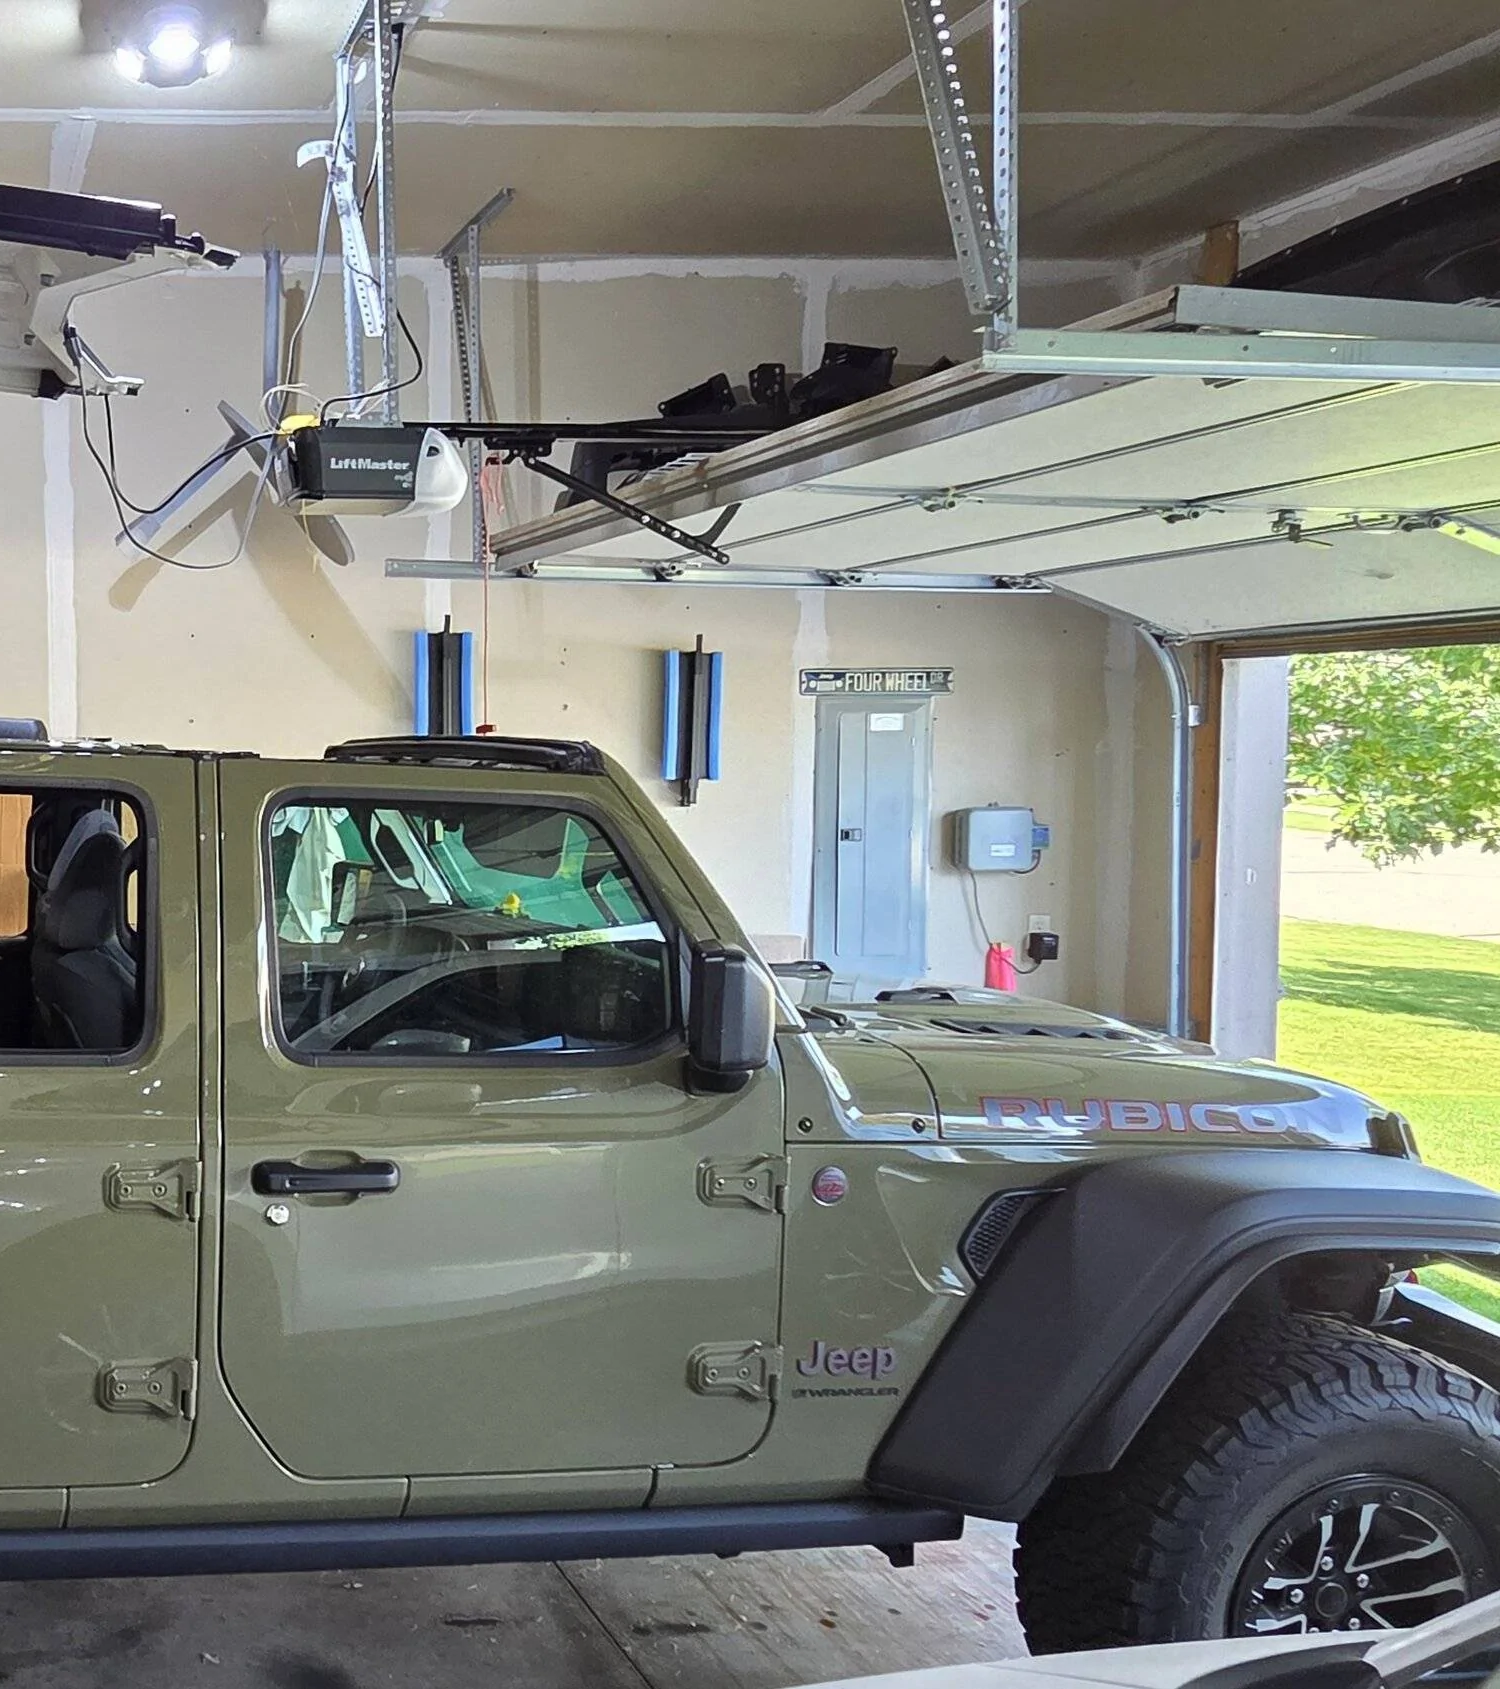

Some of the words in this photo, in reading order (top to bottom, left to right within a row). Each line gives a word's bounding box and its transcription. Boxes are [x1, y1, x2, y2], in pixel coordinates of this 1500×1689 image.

[330, 458, 410, 470] LiftMaster
[845, 673, 882, 692] FOUR
[886, 672, 931, 692] WHEEL
[980, 1096, 1344, 1133] RUBICON
[796, 1341, 898, 1380] Jeep
[807, 1387, 899, 1397] WRANGLER
